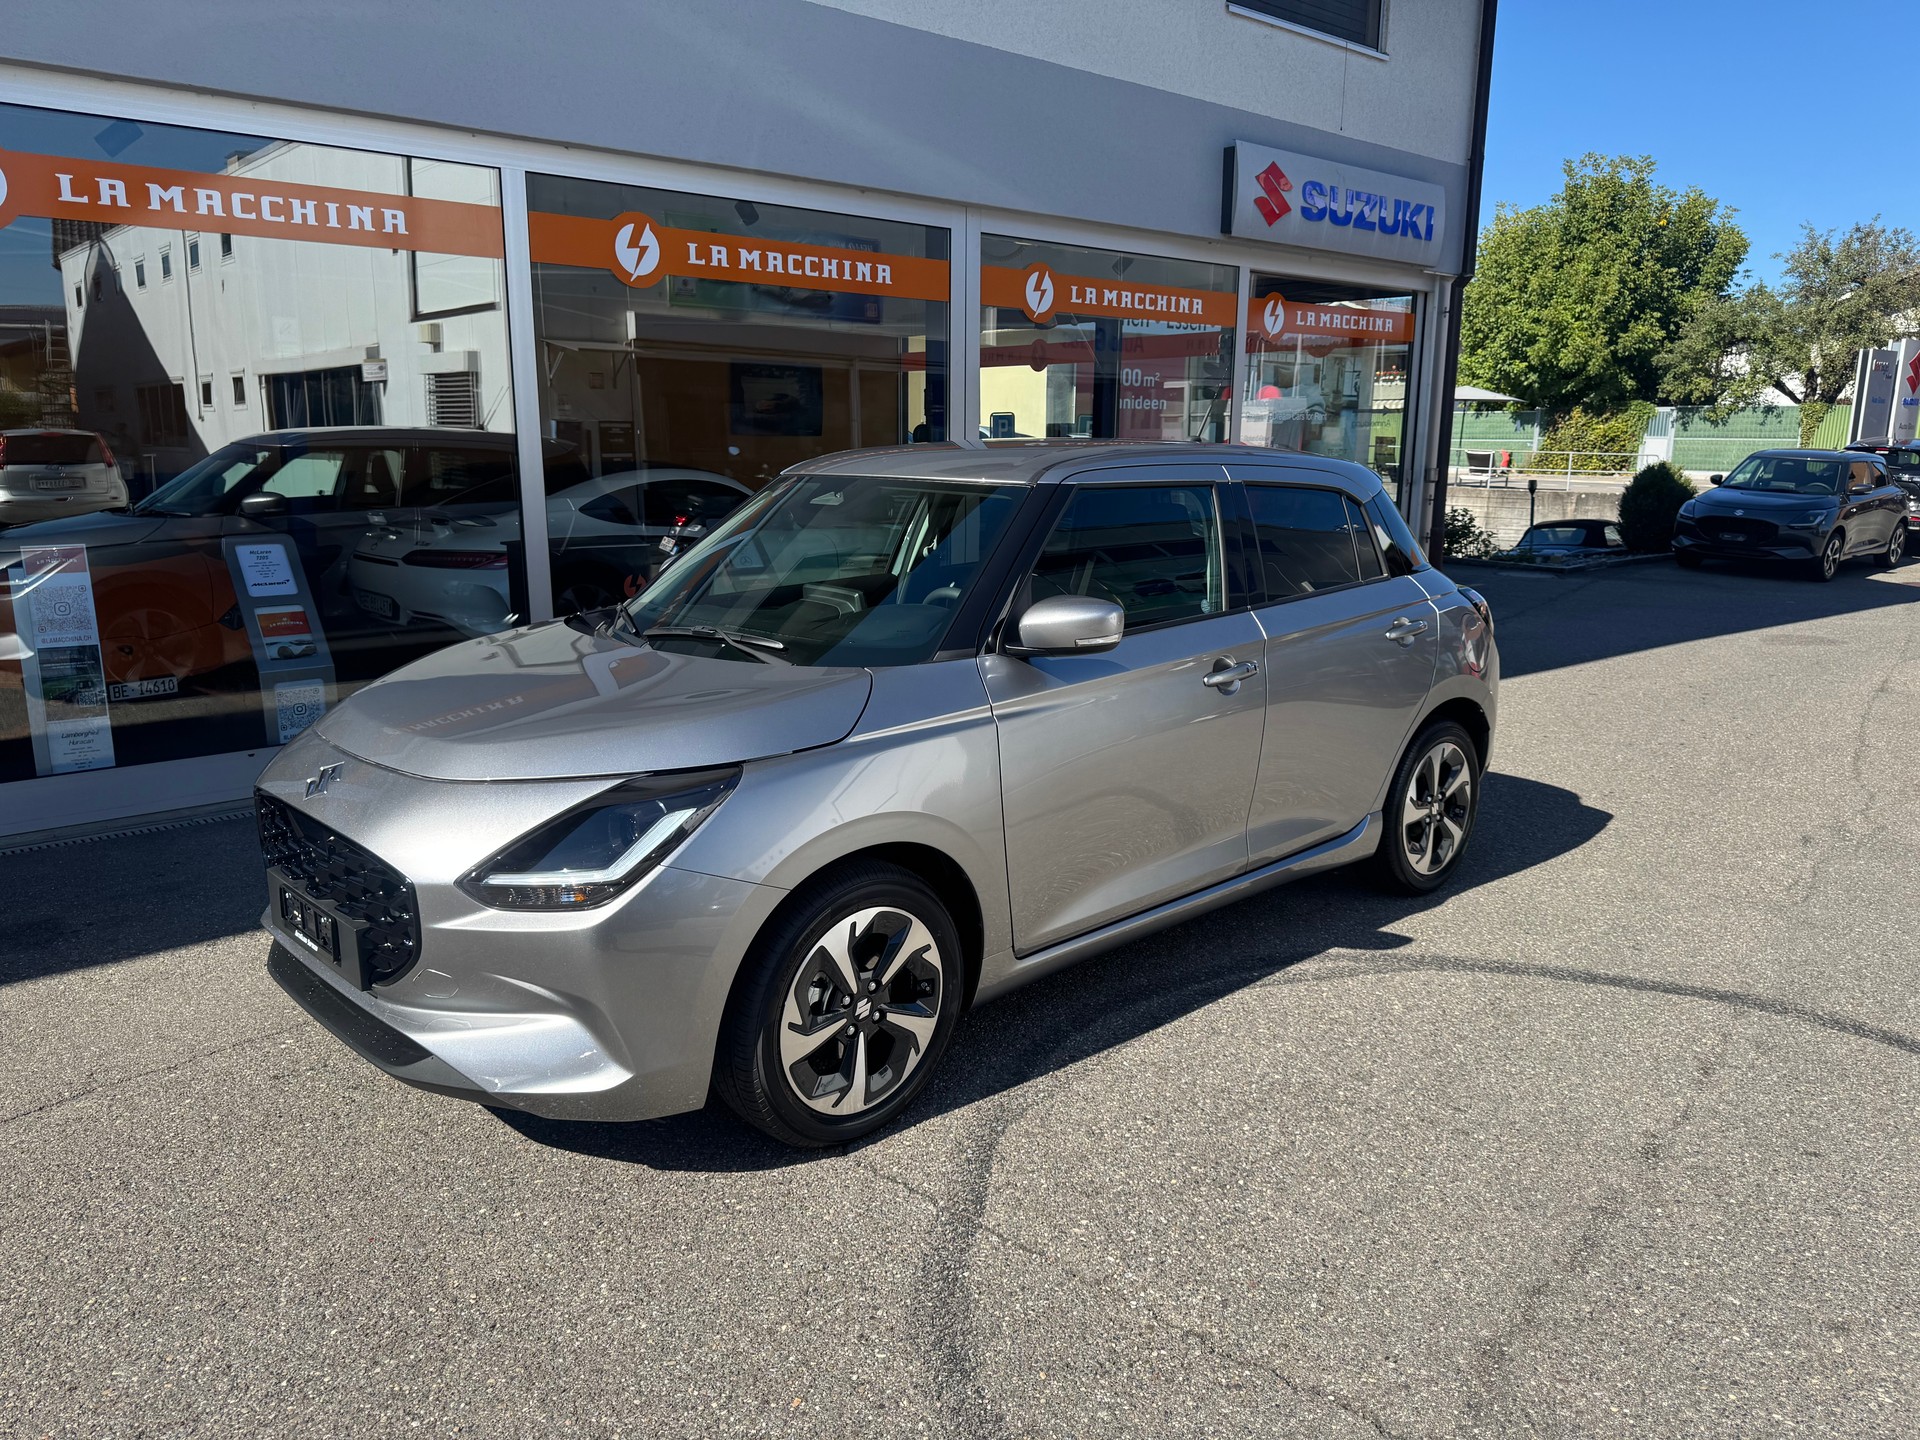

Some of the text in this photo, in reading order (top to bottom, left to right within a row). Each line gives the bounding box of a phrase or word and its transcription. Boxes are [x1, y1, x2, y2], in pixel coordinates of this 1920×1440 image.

[54, 172, 410, 236] LA MACCHINA
[1300, 180, 1435, 242] SUZUKI
[687, 242, 893, 285] LA MACCHINA
[1070, 285, 1204, 316] LA MACCHINA
[1295, 310, 1394, 333] LA MACCHINA
[1121, 368, 1142, 387] 00
[112, 679, 175, 699] BE 14610
